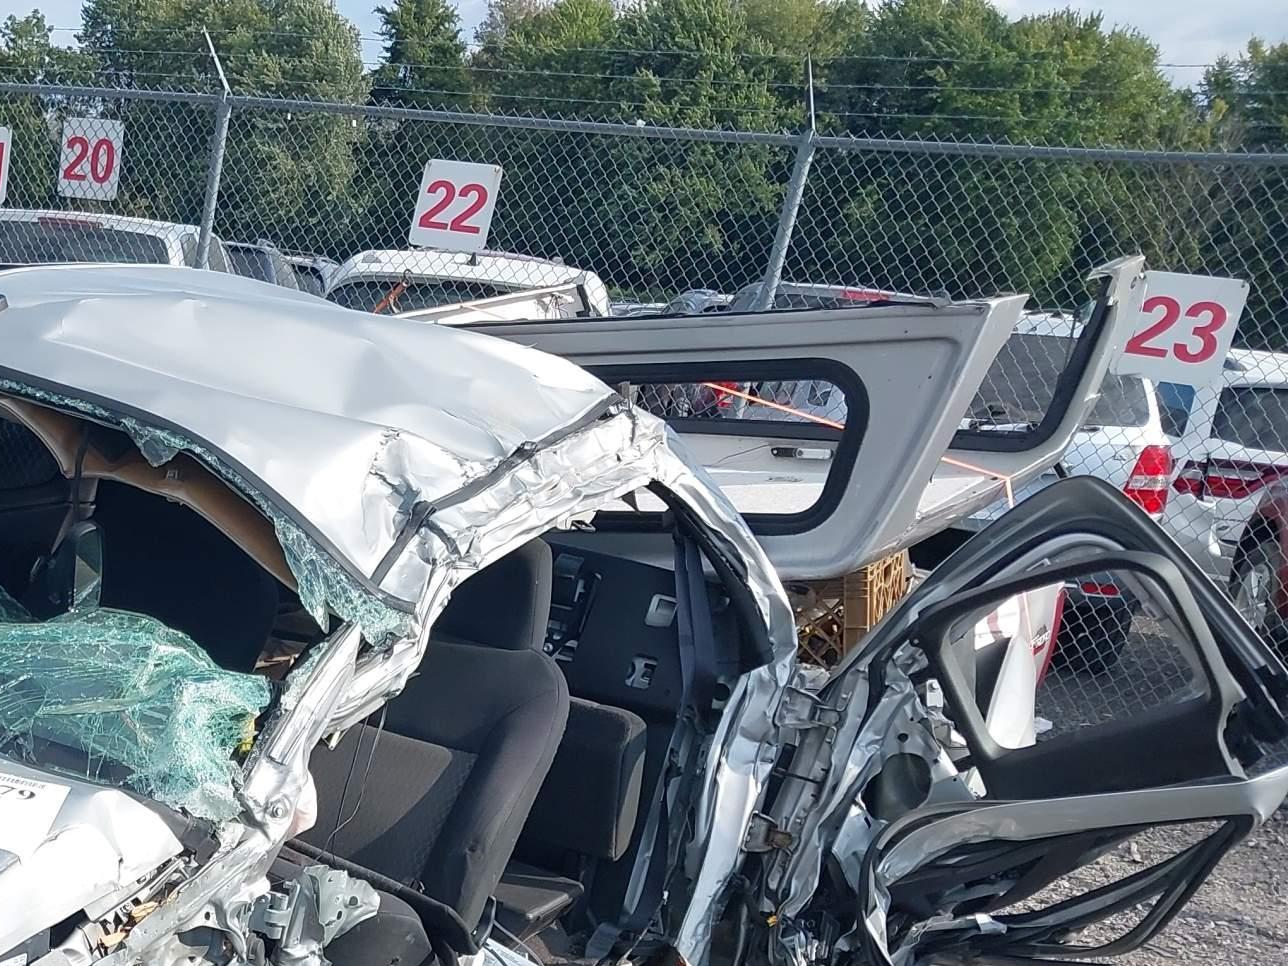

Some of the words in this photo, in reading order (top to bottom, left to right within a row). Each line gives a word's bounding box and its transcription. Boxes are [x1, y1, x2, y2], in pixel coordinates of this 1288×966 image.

[63, 136, 115, 184] 20
[418, 180, 488, 234] 22
[1124, 296, 1228, 364] 23
